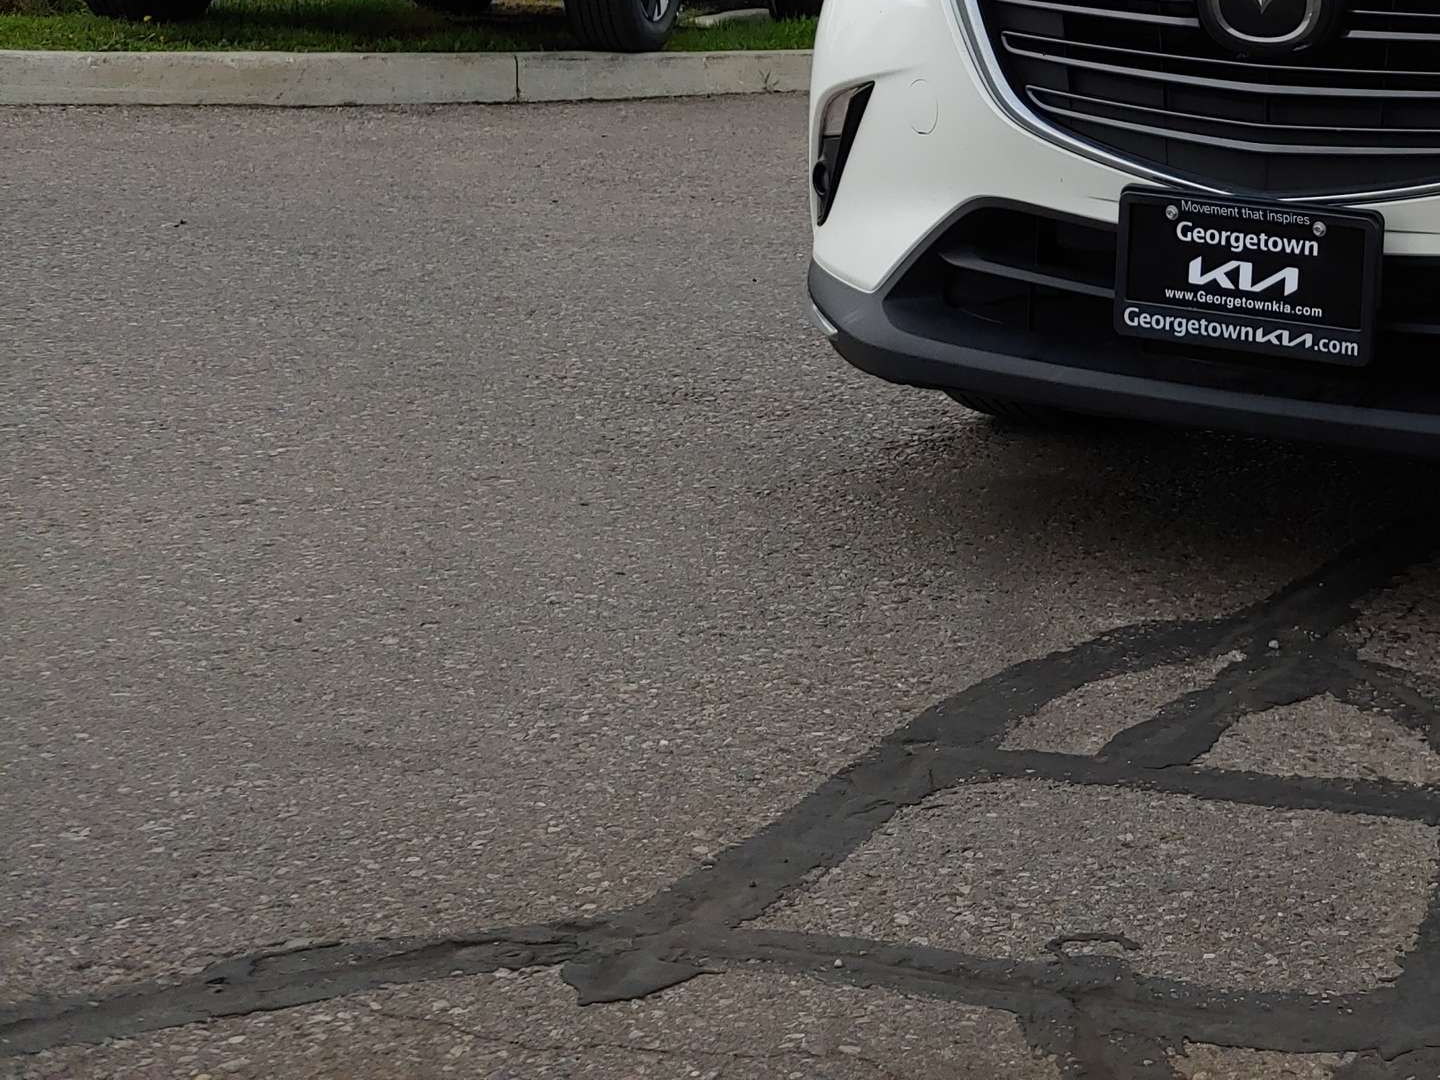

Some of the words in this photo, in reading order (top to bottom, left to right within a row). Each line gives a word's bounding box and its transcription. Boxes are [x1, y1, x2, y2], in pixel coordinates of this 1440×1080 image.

[1181, 200, 1240, 218] Movement
[1242, 208, 1264, 221] that
[1266, 211, 1310, 226] inspires
[1176, 221, 1319, 256] Georgetown
[1188, 256, 1299, 296] KIA
[1165, 288, 1323, 318] www.Georgetownkia.com
